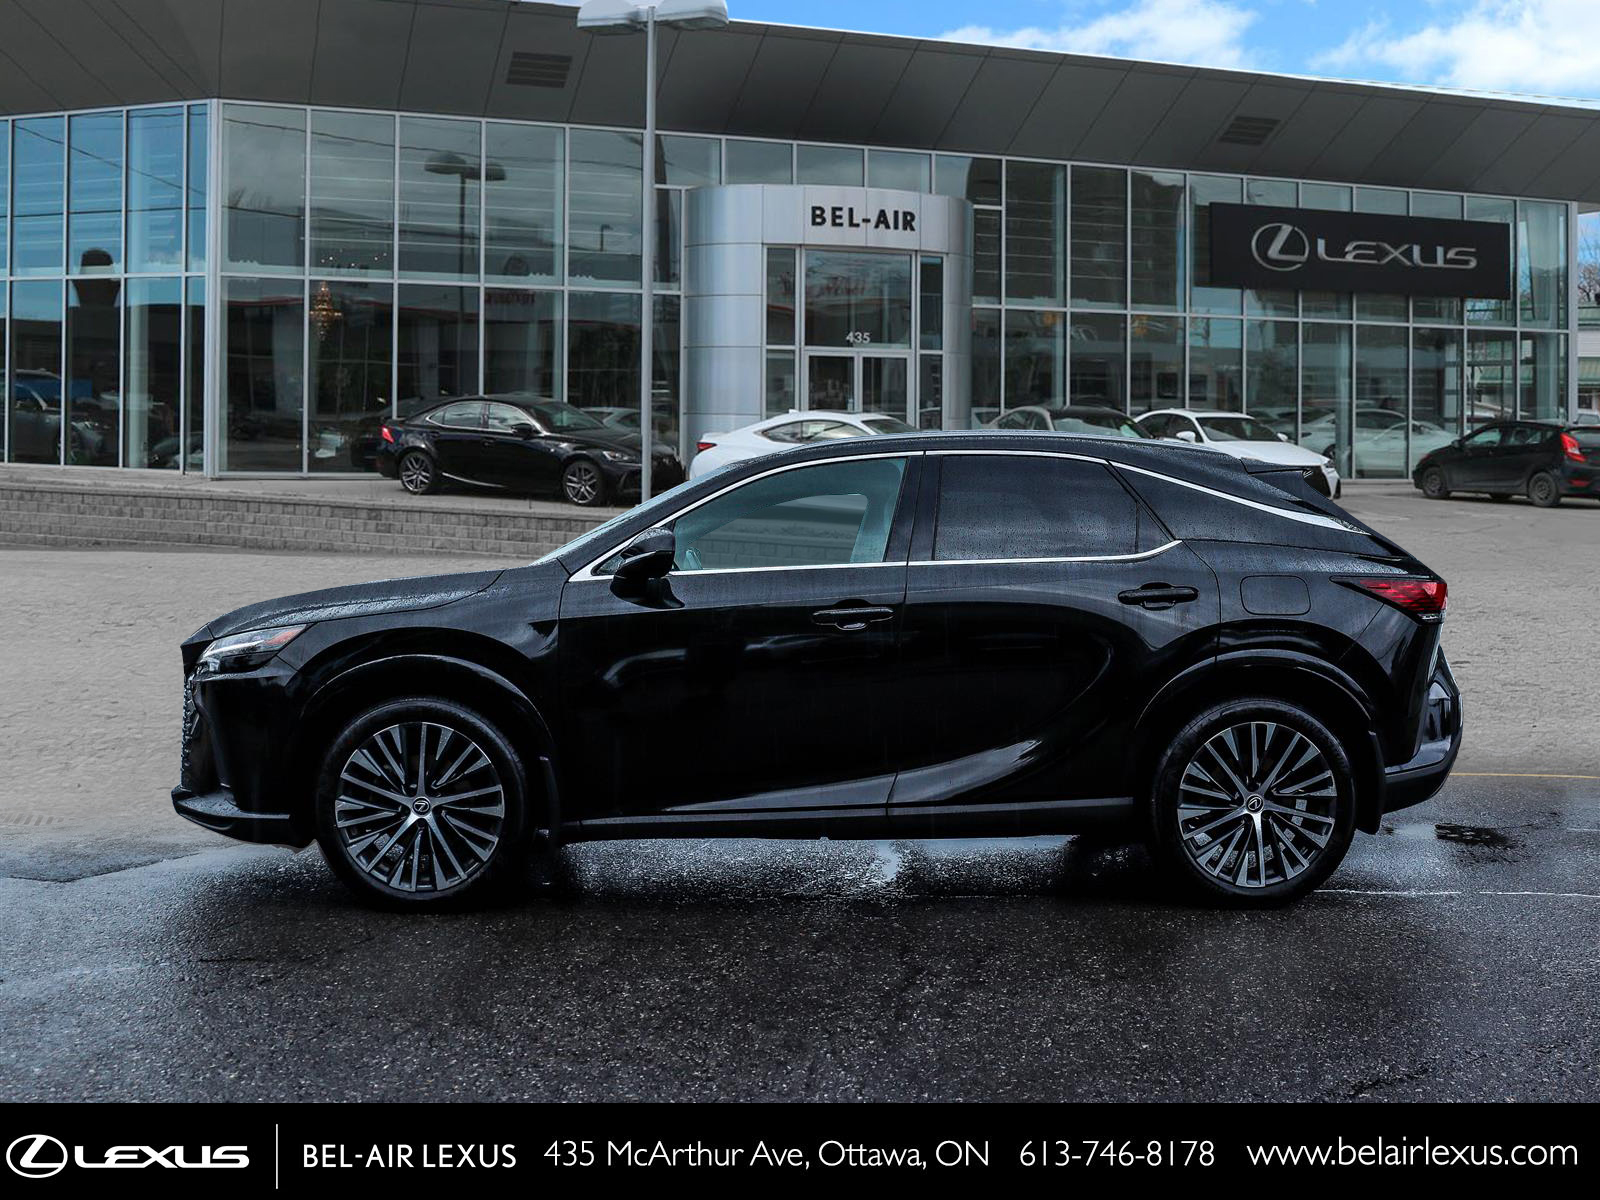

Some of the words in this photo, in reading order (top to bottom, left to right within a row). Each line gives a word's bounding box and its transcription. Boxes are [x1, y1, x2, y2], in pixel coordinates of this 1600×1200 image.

[811, 205, 916, 232] BEL-AIR
[1316, 238, 1478, 269] LEXUS
[846, 331, 871, 344] 435
